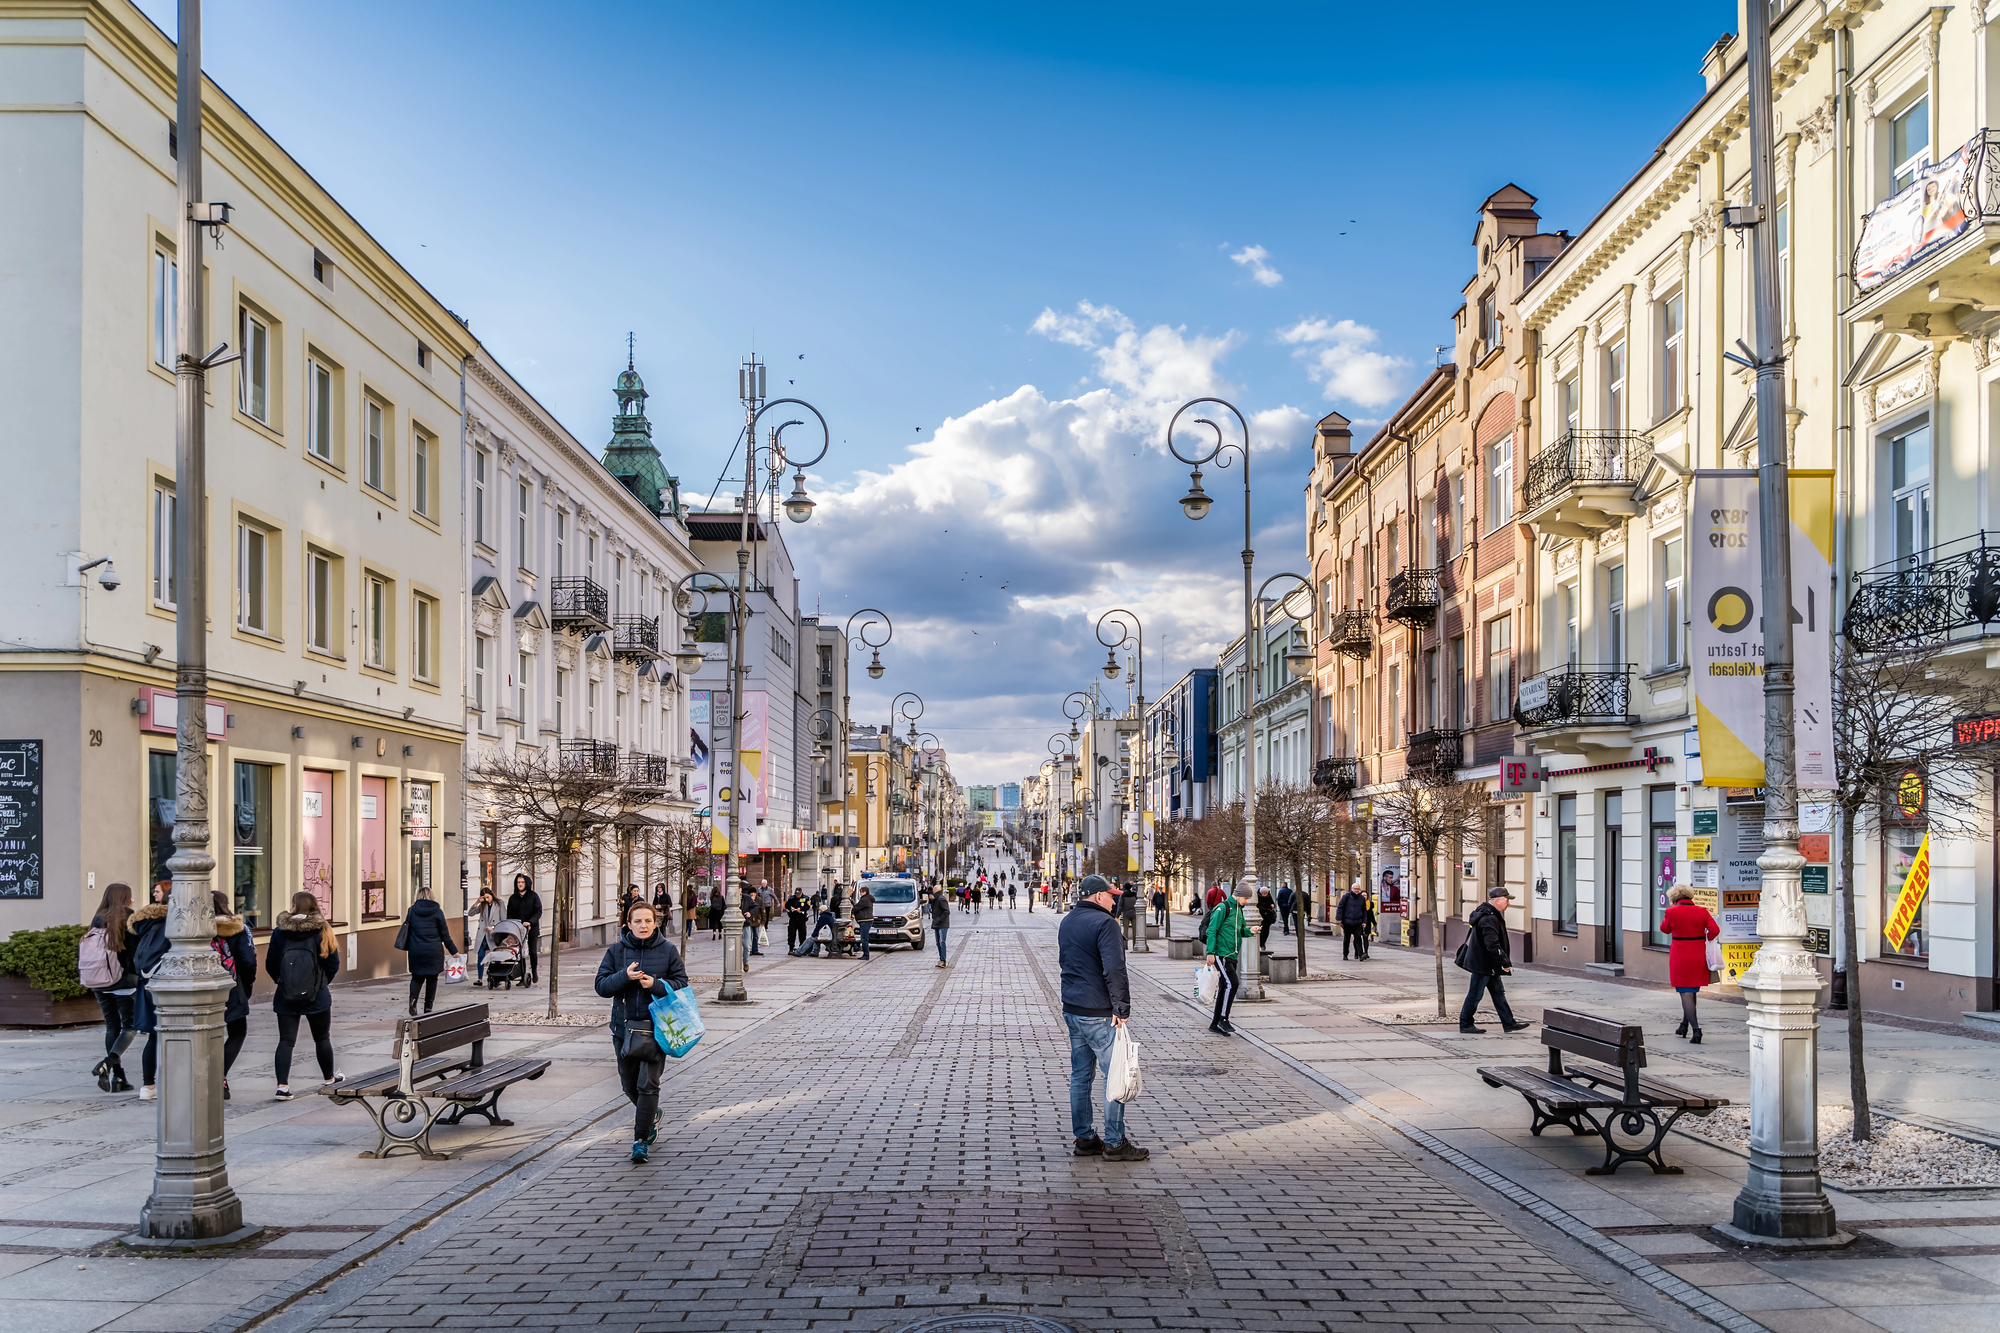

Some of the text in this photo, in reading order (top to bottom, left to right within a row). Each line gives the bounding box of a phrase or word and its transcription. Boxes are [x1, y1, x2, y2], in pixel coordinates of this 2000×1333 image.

[690, 692, 708, 700] UX
[89, 728, 103, 747] 29
[1507, 763, 1526, 785] T
[1888, 834, 1930, 947] WYPRZEDA
